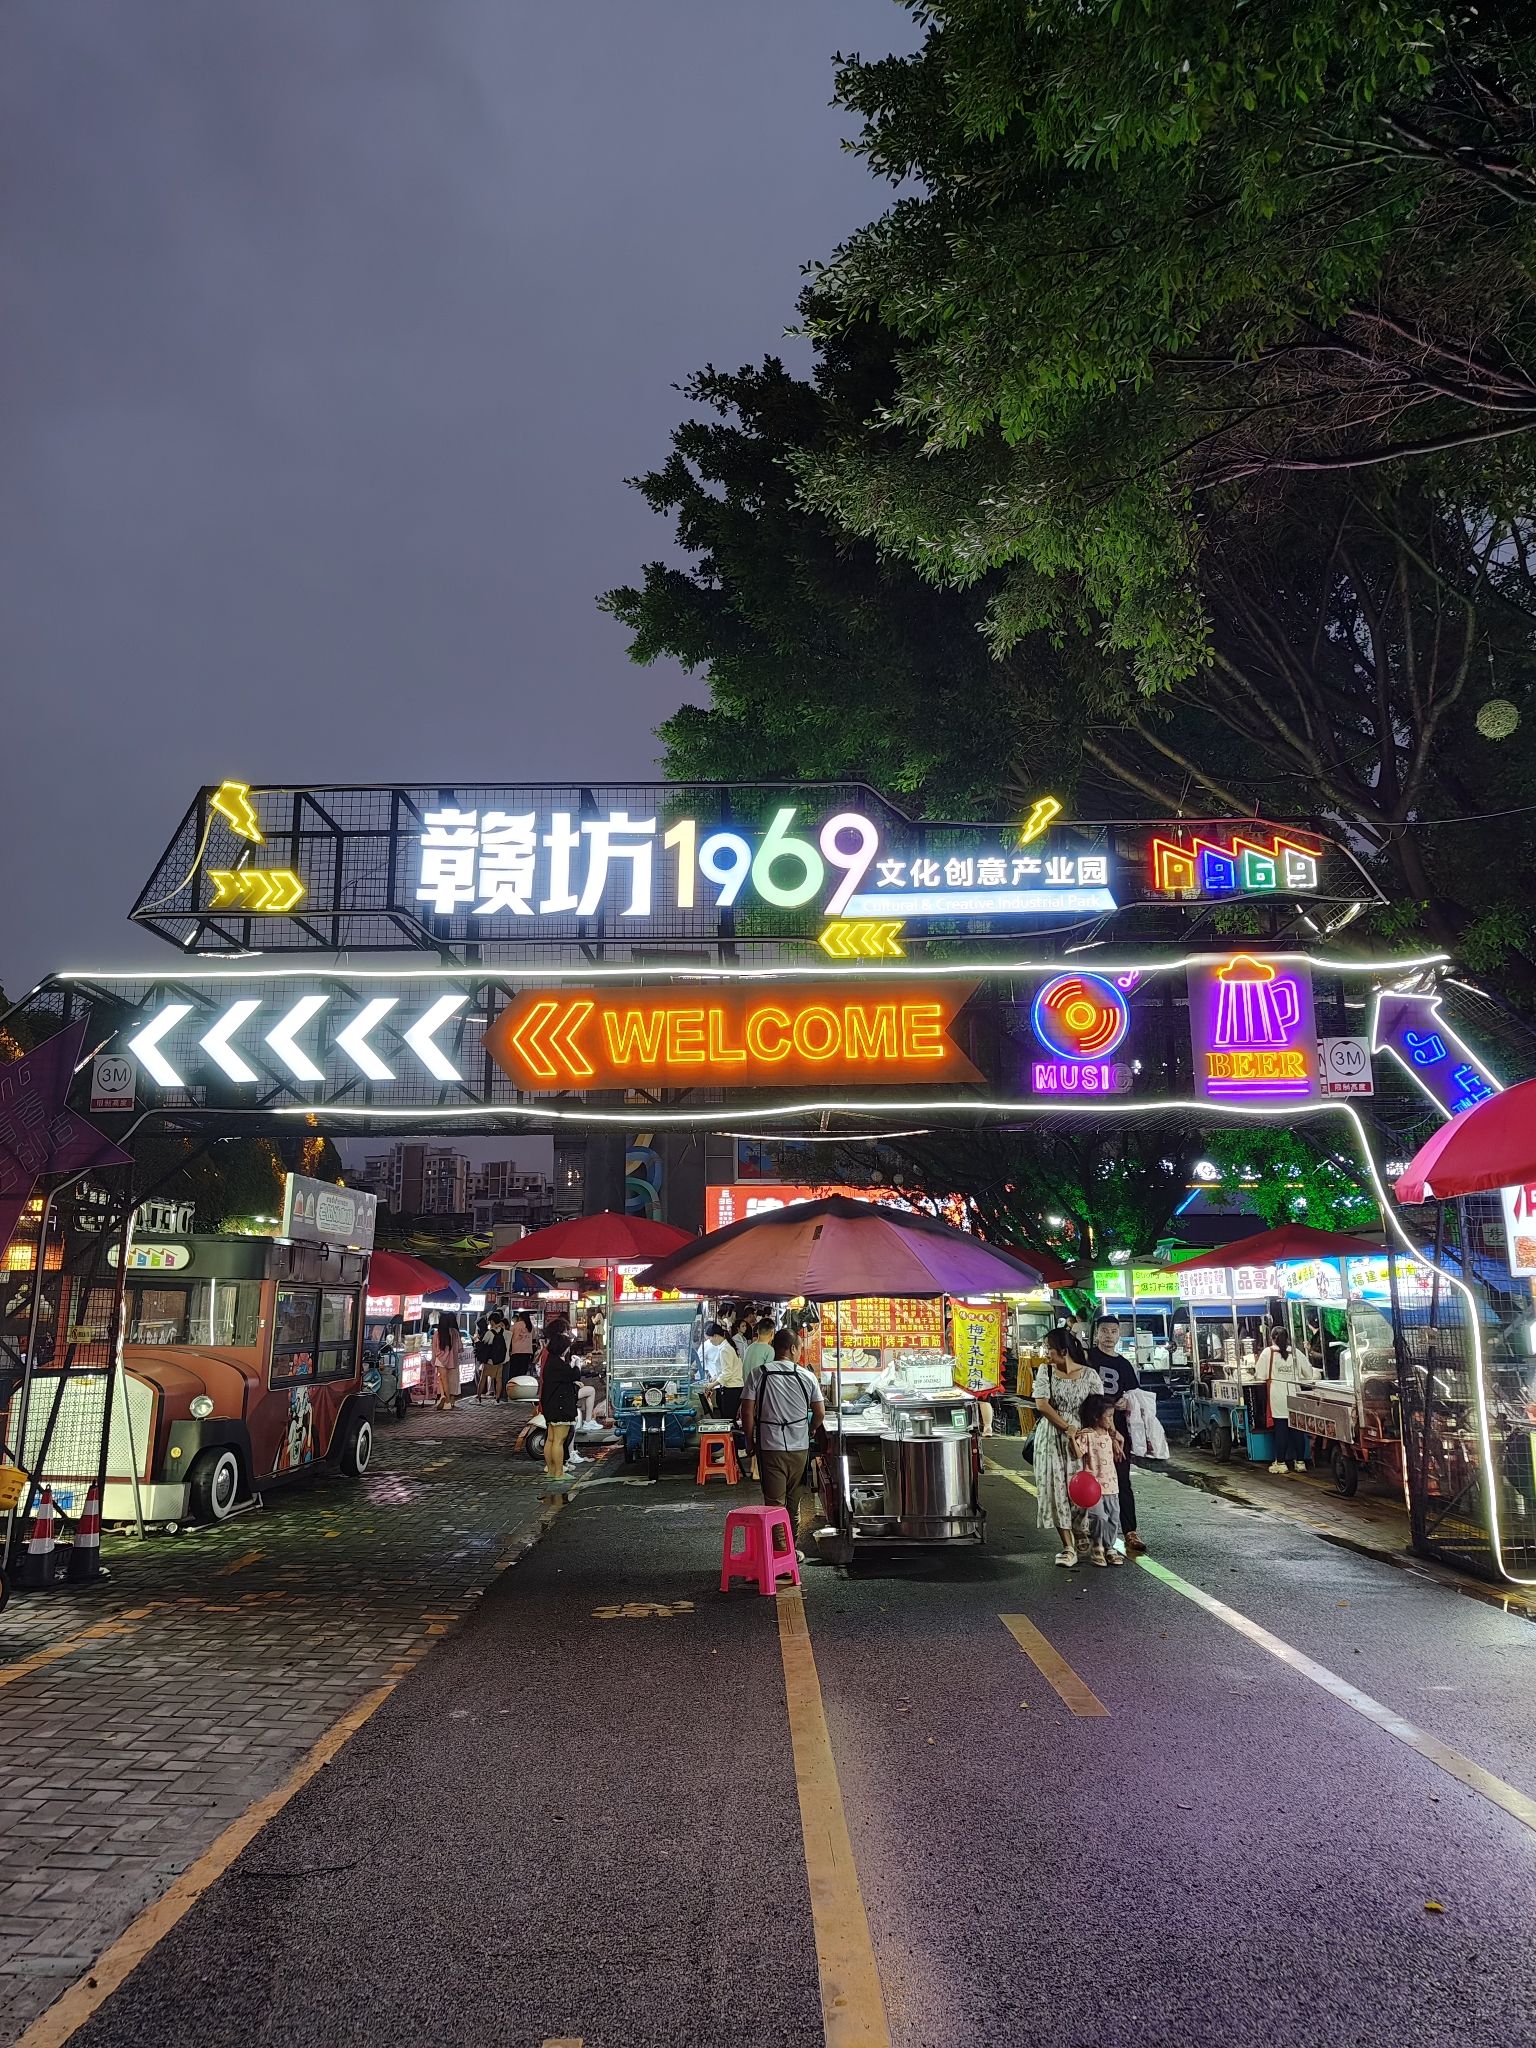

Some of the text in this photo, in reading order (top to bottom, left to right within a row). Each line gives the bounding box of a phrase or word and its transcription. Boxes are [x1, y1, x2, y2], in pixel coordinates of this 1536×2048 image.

[876, 856, 1108, 888] 文化创意产业园
[863, 893, 1100, 912] Cultural & Creative Industrial Park
[603, 1004, 944, 1064] WELCOME
[1206, 1052, 1308, 1079] BEER
[1335, 1051, 1362, 1066] 3M
[102, 1068, 127, 1082] 3M
[1036, 1064, 1133, 1092] MUSIC
